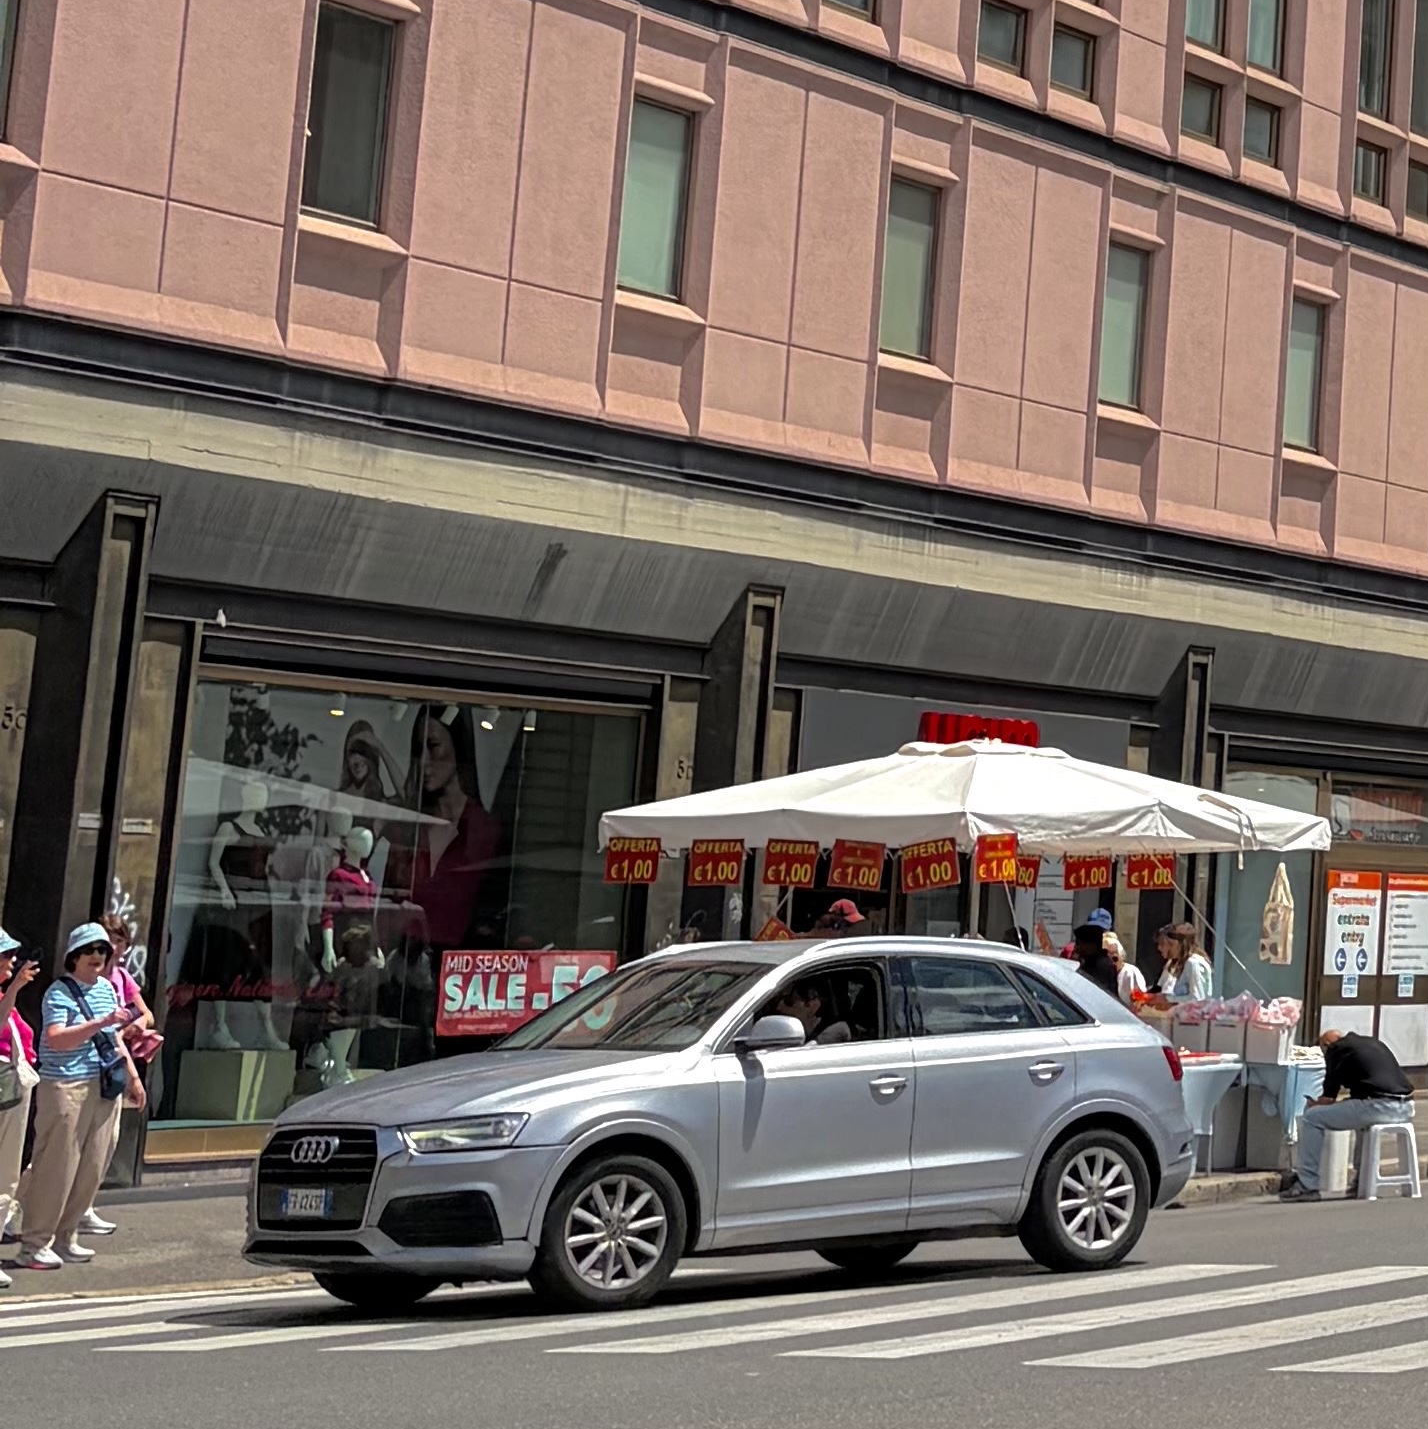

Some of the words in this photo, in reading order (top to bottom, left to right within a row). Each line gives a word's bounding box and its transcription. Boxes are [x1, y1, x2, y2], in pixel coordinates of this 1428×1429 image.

[610, 839, 658, 852] OFFERTA
[694, 841, 742, 853] OFFERTA
[769, 842, 816, 855] OFFERTA
[446, 956, 473, 972] MID
[475, 955, 529, 972] SEASON
[444, 974, 527, 1013] SALE
